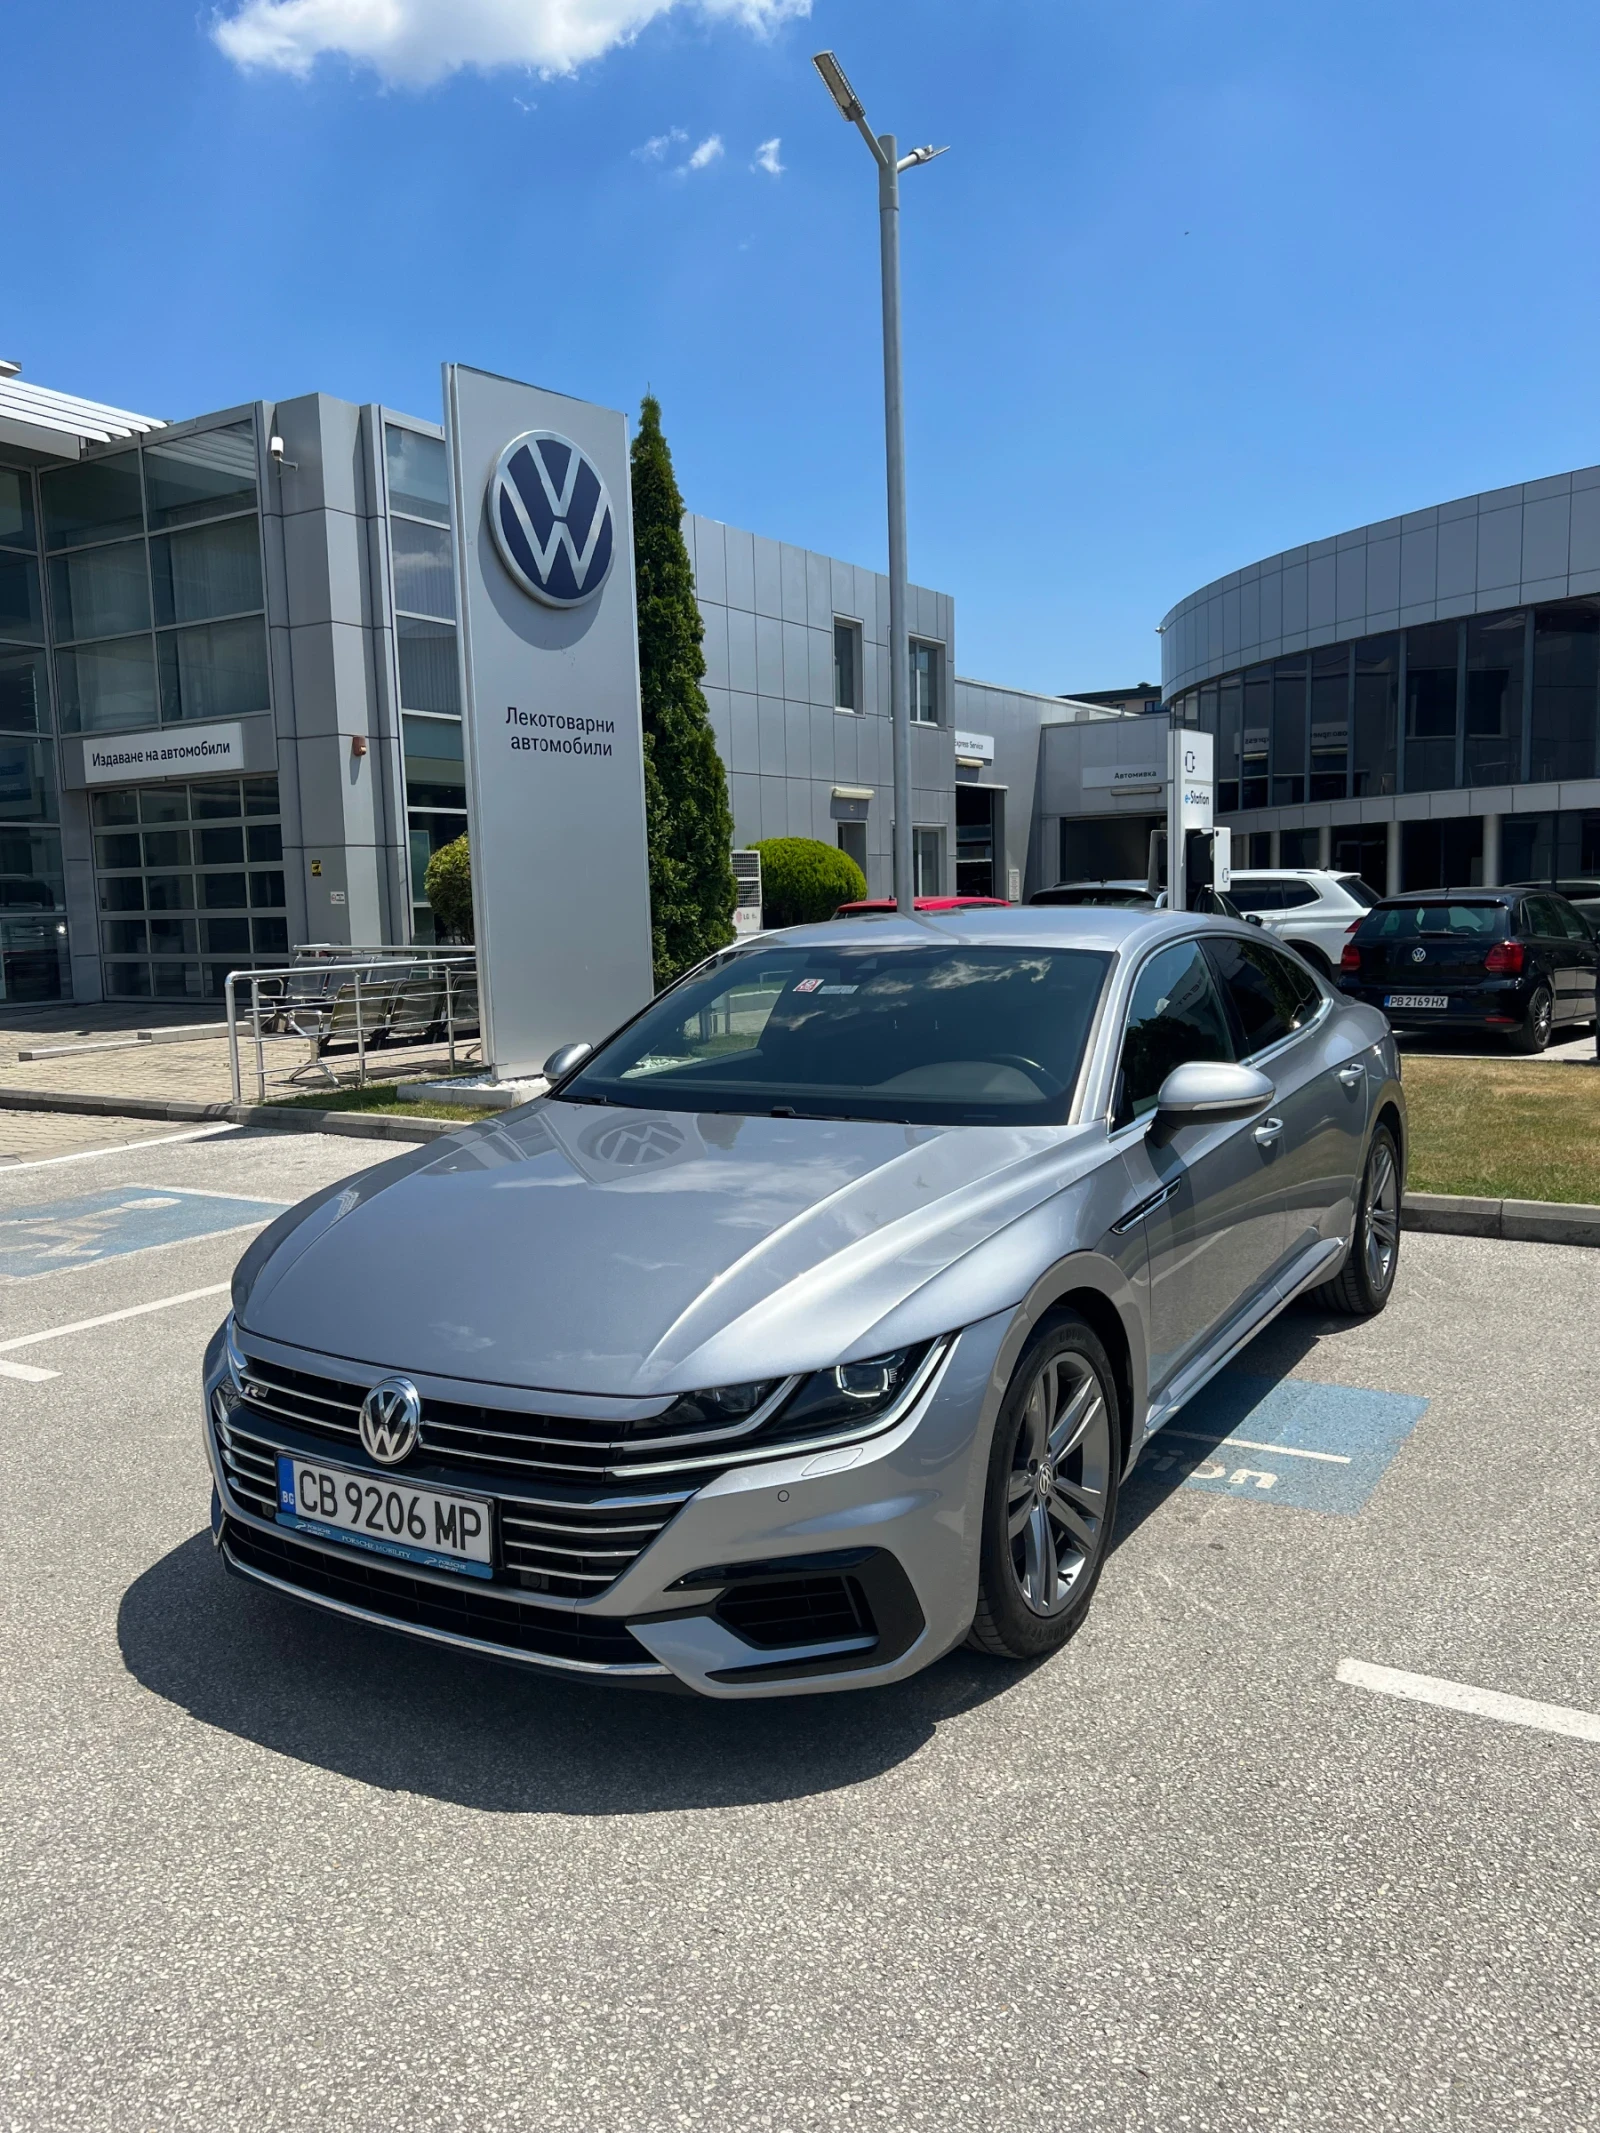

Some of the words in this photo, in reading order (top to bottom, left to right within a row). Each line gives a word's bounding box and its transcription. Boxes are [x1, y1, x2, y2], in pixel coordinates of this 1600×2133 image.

[505, 706, 615, 735] Лекотоварни
[511, 735, 613, 757] автомобили
[969, 741, 984, 750] Service
[92, 752, 144, 767] Издаване
[145, 750, 159, 762] на
[160, 740, 231, 760] автомобили
[1114, 769, 1157, 780] Автомивка
[1184, 790, 1210, 805] e-Station
[1390, 996, 1405, 1007] PB
[1405, 996, 1430, 1007] 2169
[1431, 997, 1447, 1008] HX
[281, 1490, 295, 1505] BG
[299, 1469, 338, 1518] CB
[345, 1481, 427, 1541] 9206
[434, 1500, 482, 1551] MP
[307, 1523, 332, 1535] PORSCHE
[341, 1535, 376, 1550] PORSCHE
[375, 1544, 411, 1559] MOBILITY
[438, 1558, 467, 1571] PORSCHE
